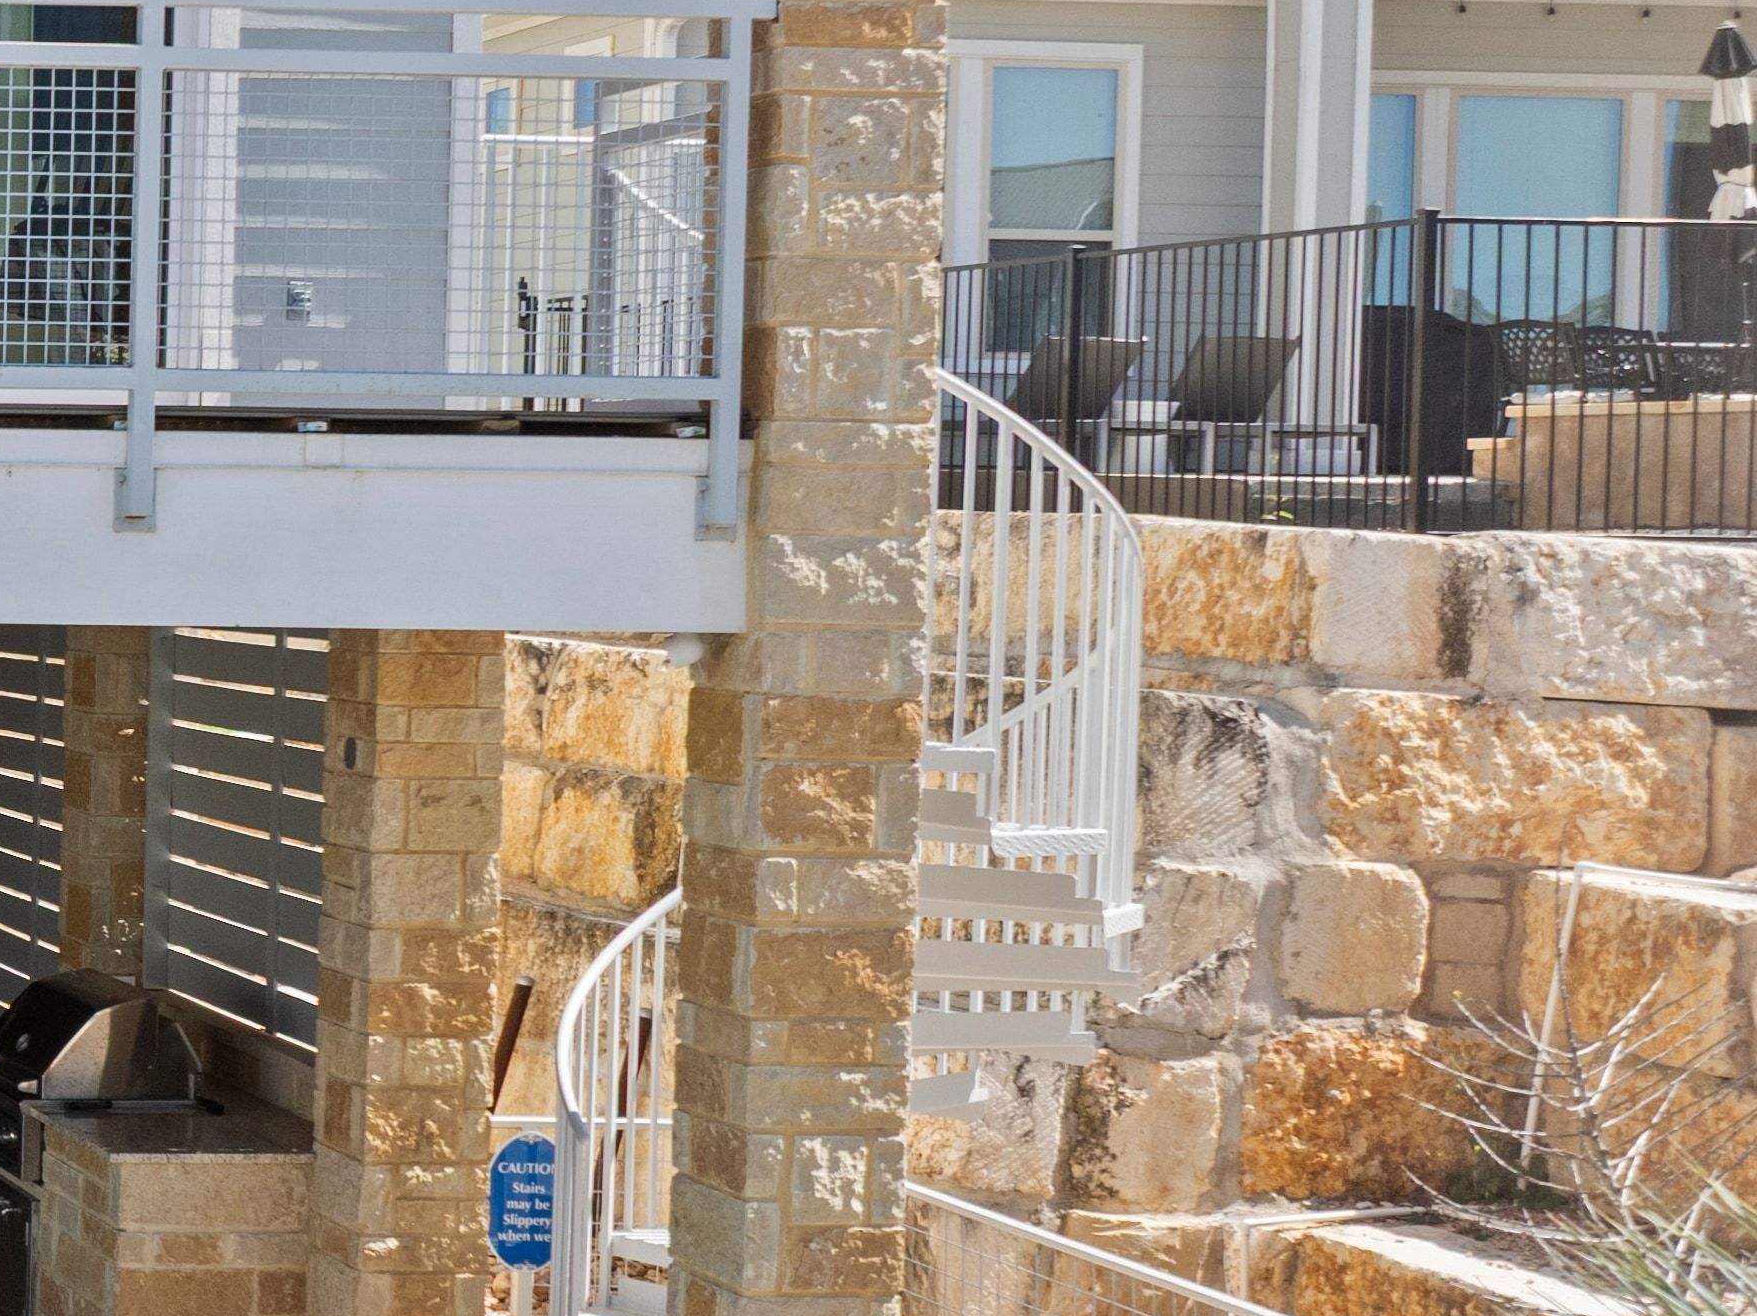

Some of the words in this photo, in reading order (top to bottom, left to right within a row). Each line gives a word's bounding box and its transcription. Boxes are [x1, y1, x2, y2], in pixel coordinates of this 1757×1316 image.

[513, 1182, 546, 1194] Stairs
[507, 1200, 531, 1212] may
[535, 1198, 550, 1210] be
[503, 1213, 551, 1229] Slippery
[498, 1230, 531, 1241] when
[534, 1233, 552, 1242] we
